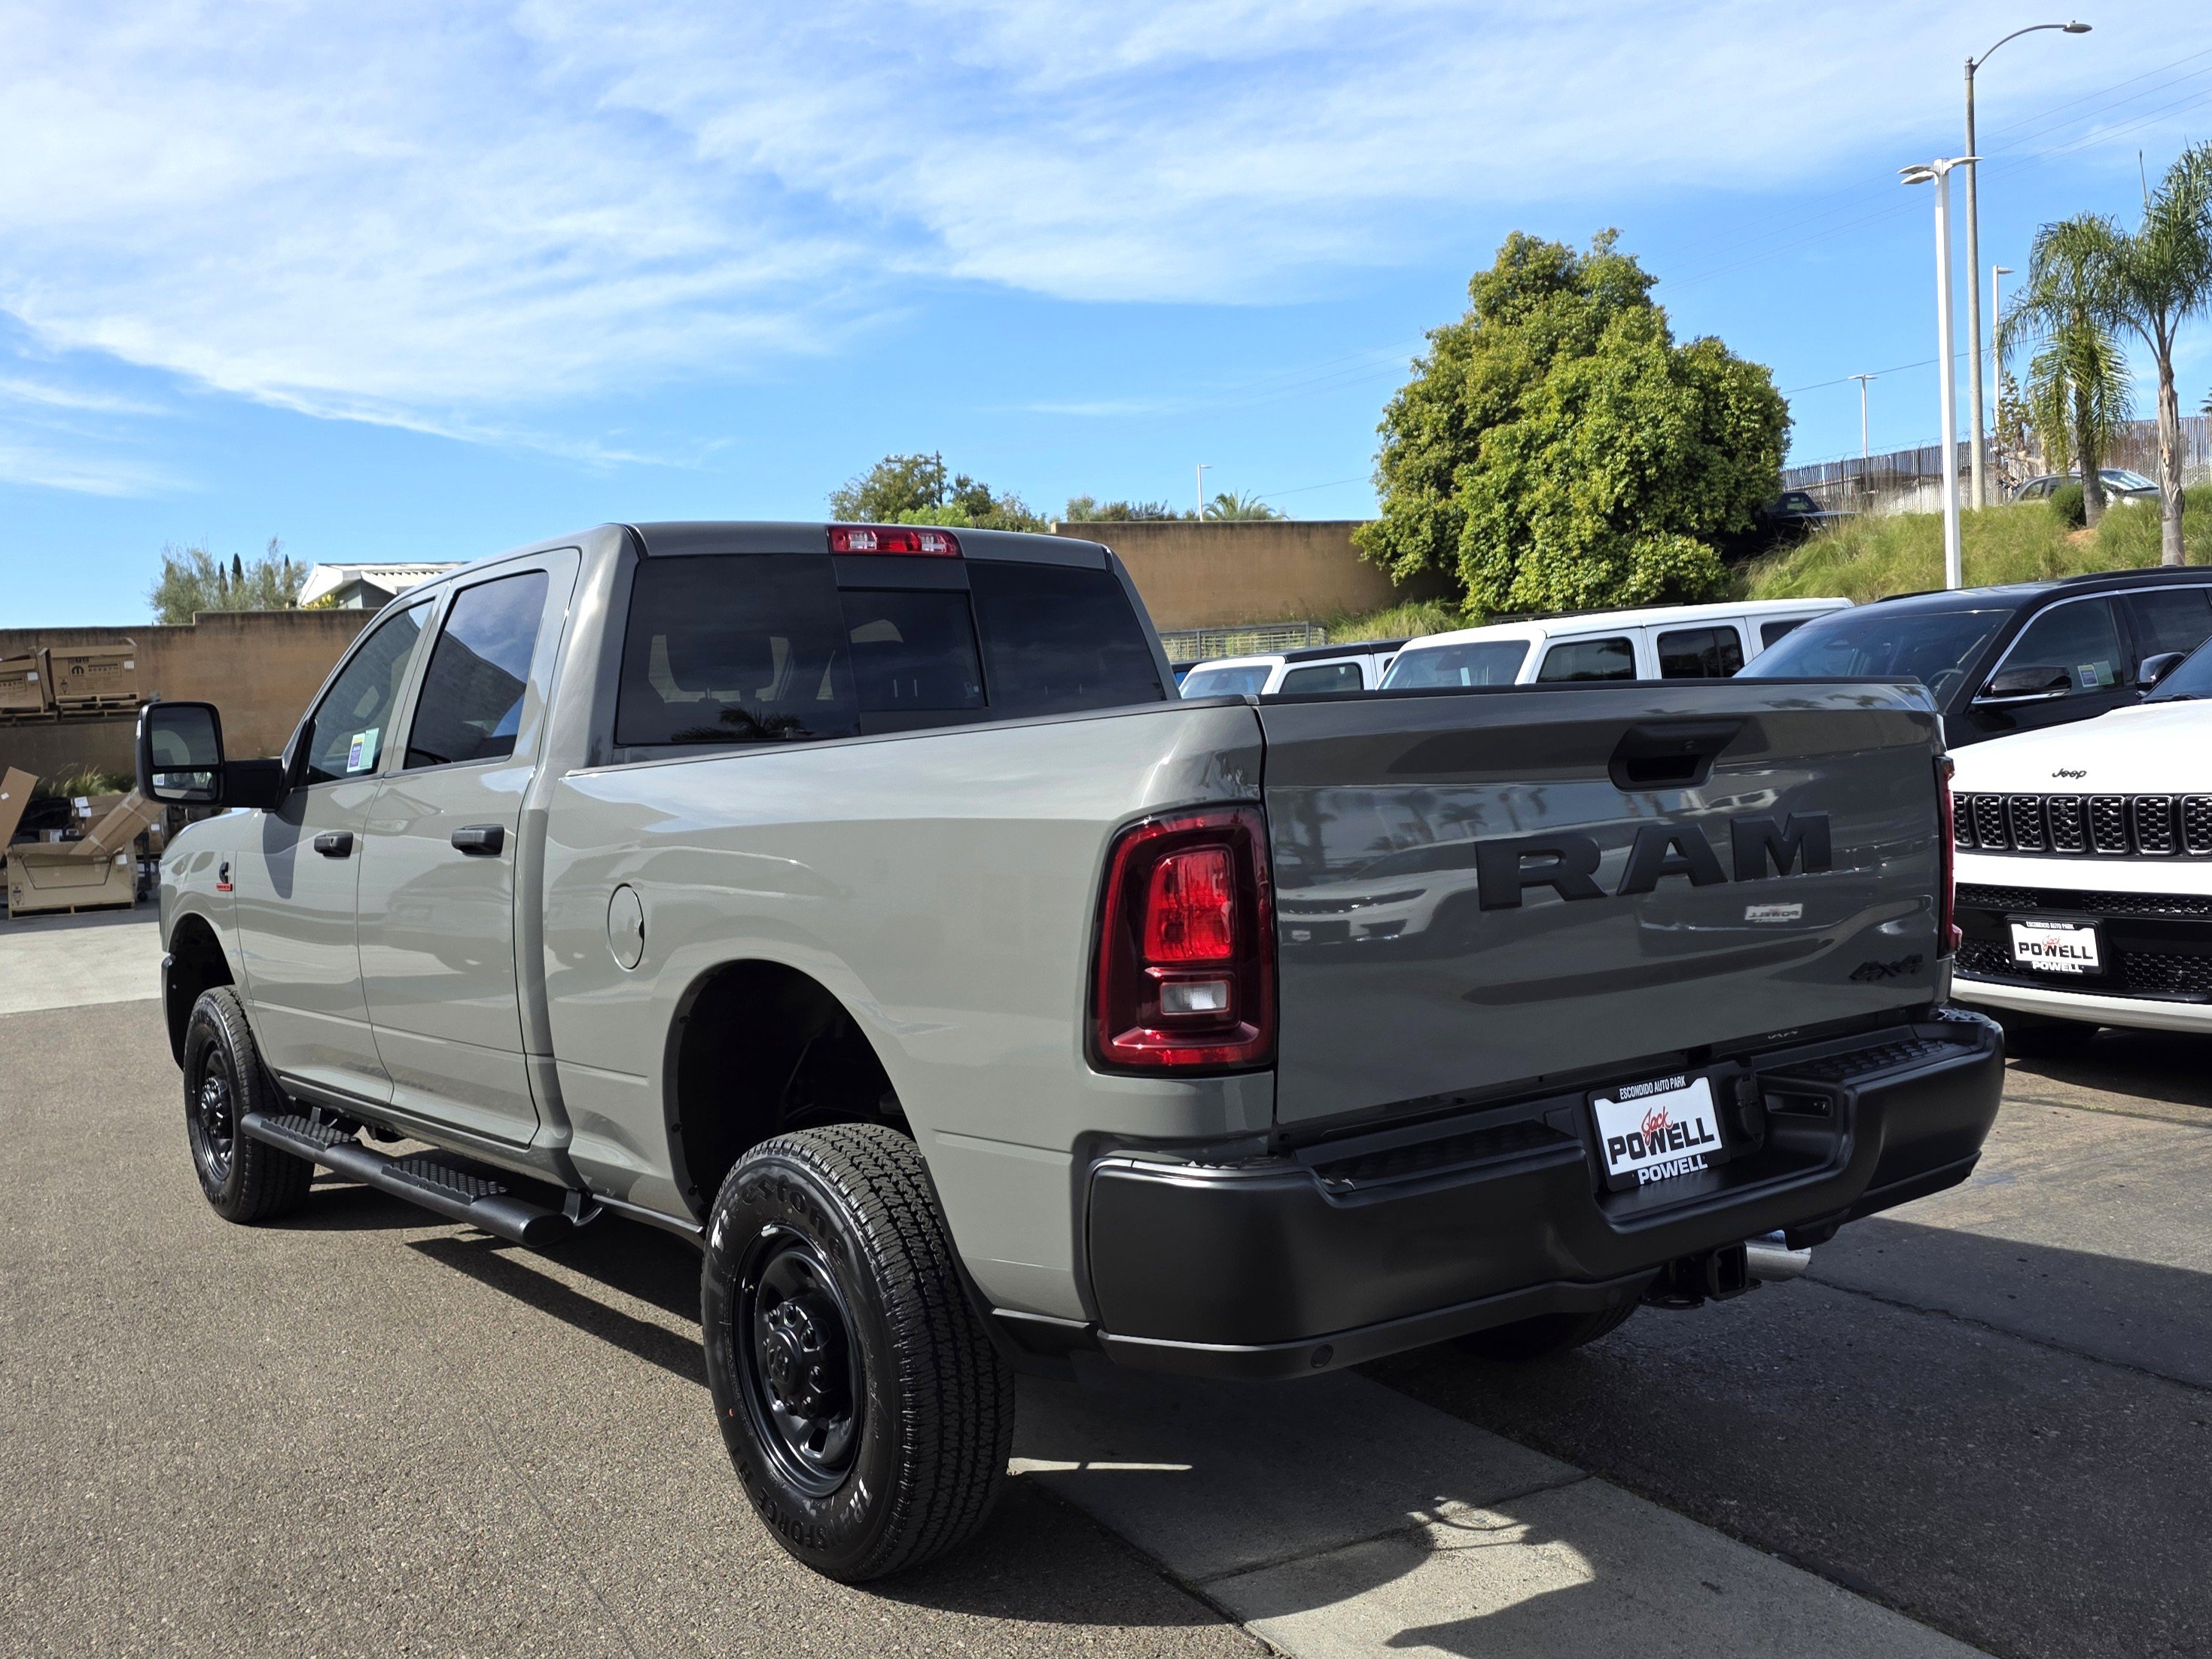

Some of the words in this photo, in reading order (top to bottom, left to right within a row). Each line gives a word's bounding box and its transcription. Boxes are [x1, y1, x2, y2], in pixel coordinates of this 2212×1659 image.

[2052, 768, 2087, 779] Jeep
[1475, 810, 1833, 911] RAM
[2019, 942, 2093, 959] POWELL
[2043, 935, 2062, 952] Jack
[2032, 960, 2083, 973] POWELL
[1619, 1084, 1653, 1100] ESCONDIDO
[1654, 1078, 1670, 1093] AUTO
[1670, 1075, 1686, 1090] PARK
[1641, 1105, 1674, 1147] Jack
[1607, 1118, 1715, 1165] POWELL
[1638, 1154, 1708, 1185] POWELL
